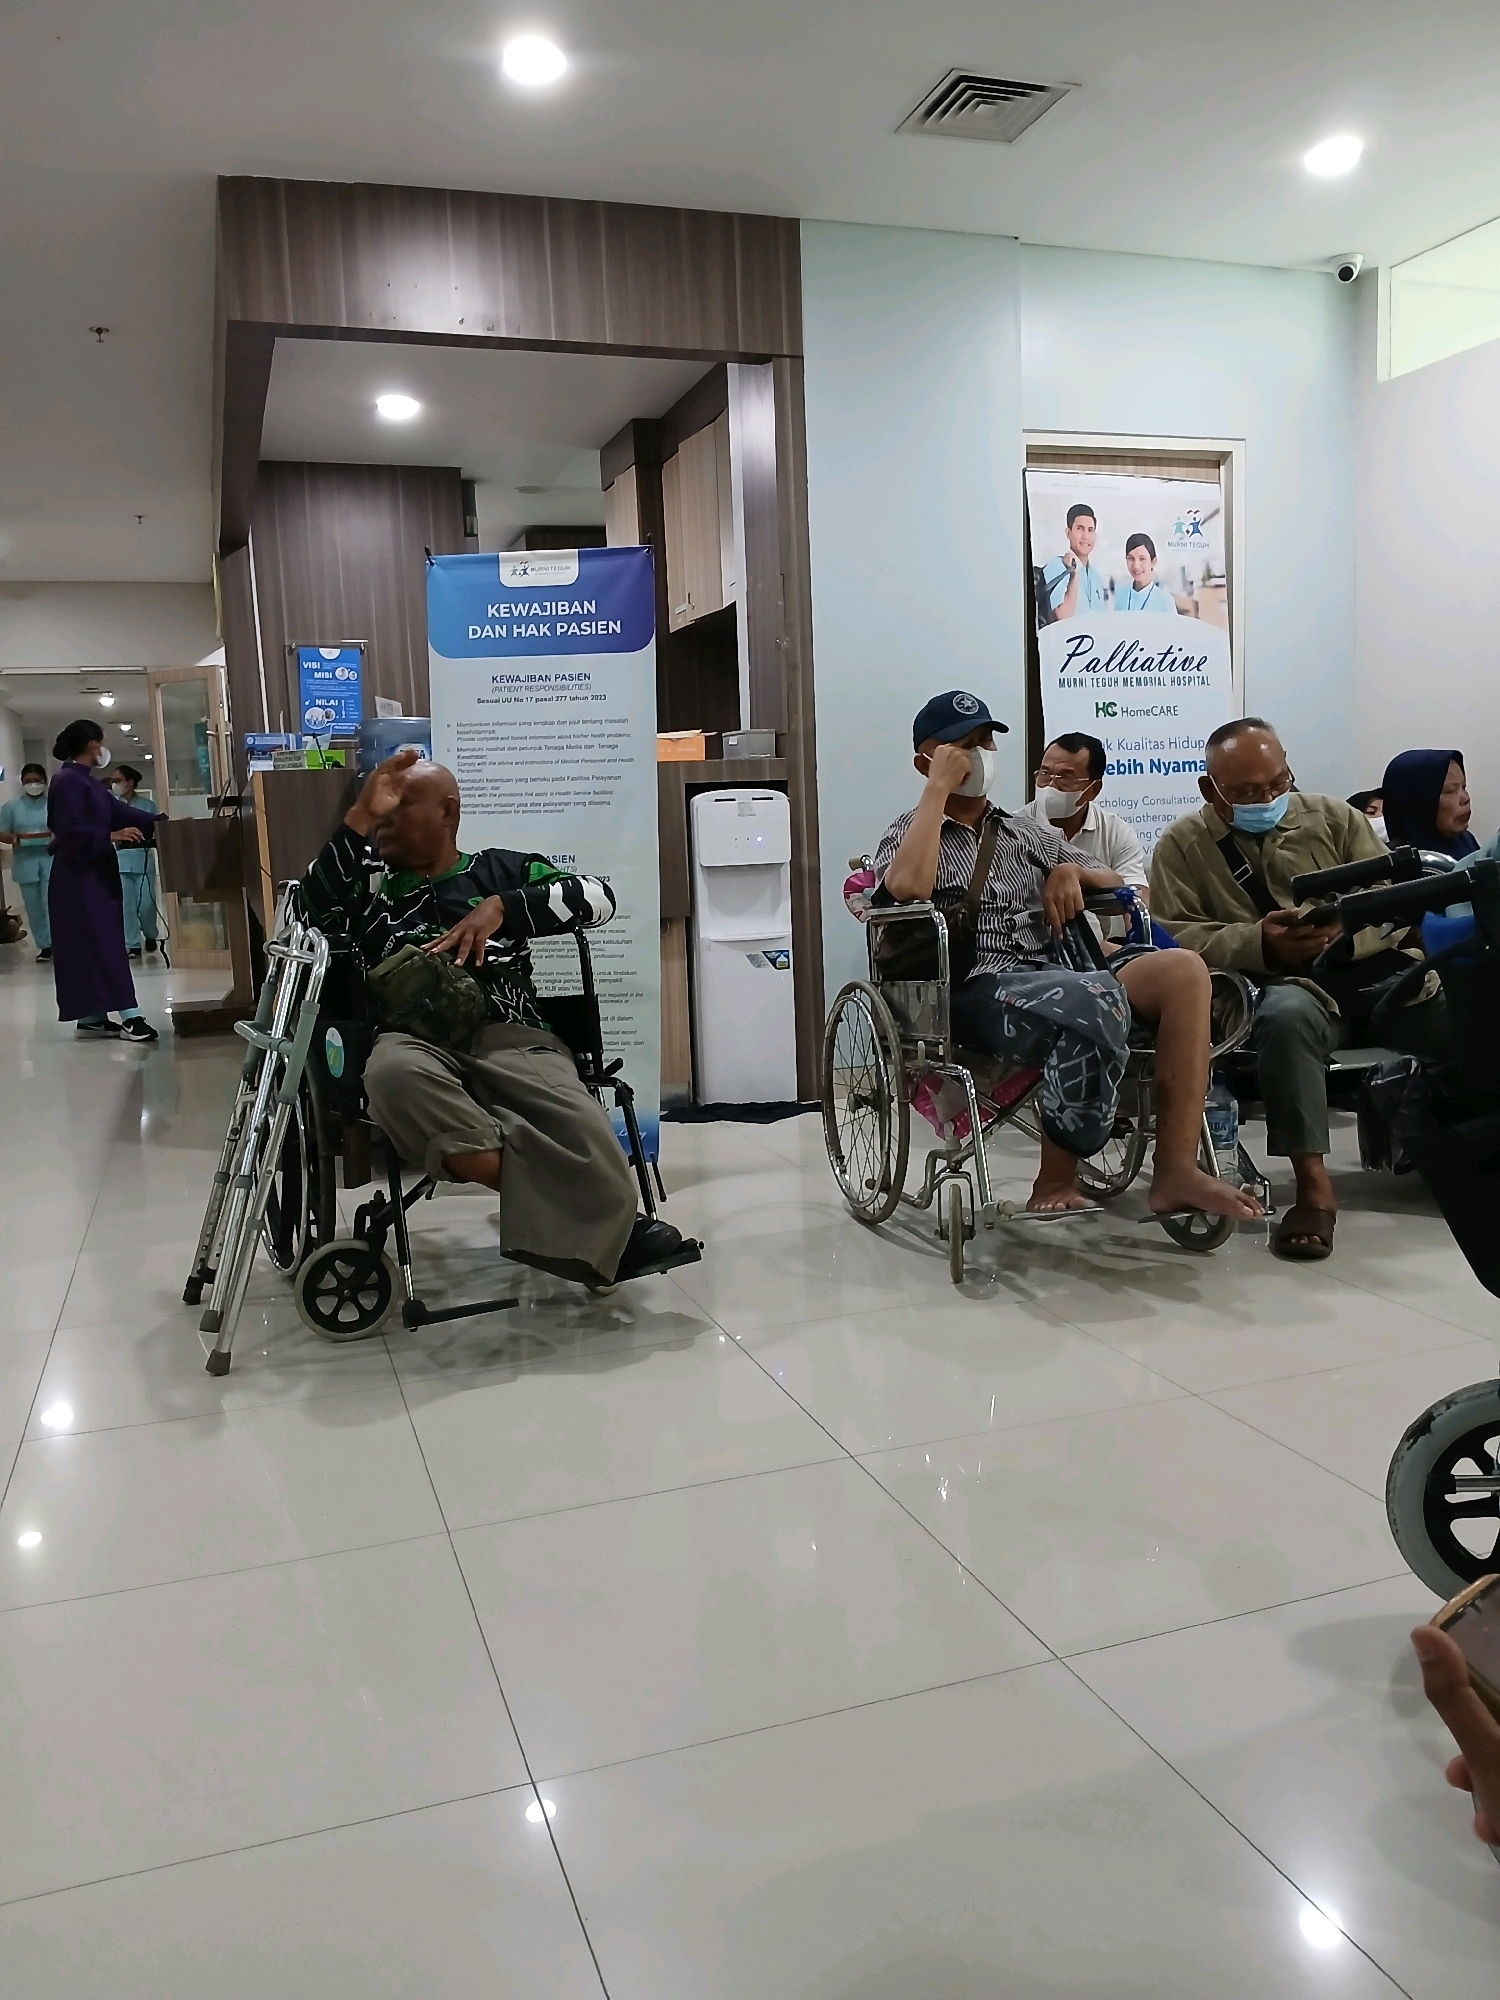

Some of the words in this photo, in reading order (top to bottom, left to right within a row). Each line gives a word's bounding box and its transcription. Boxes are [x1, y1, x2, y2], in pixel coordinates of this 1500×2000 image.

[487, 600, 596, 618] KEWAJIBAN
[468, 625, 507, 640] DAN
[512, 622, 551, 638] HAK
[556, 620, 622, 636] PASIEN
[1059, 634, 1208, 674] Palliative
[492, 674, 552, 684] KEWAJIBAN
[554, 672, 591, 682] PASIEN
[1058, 677, 1087, 688] MURNI
[1090, 676, 1119, 688] TEGUH
[1122, 676, 1167, 687] MEMORIAL
[1170, 675, 1211, 686] HOSPITAL
[492, 686, 524, 694] (PATIENT
[524, 684, 592, 692] RESPONSIBILITIES)
[316, 698, 338, 706] NILAI
[1120, 705, 1179, 718] HomeCARE
[1117, 737, 1165, 751] Kualitas
[1168, 736, 1205, 751] Hidup
[1106, 759, 1144, 775] ebih
[1149, 758, 1207, 776] Nyama
[1099, 796, 1138, 809] chology
[1142, 794, 1200, 806] Consultation
[1120, 812, 1177, 824] ysiotherapy
[546, 854, 576, 864] ASIEN
